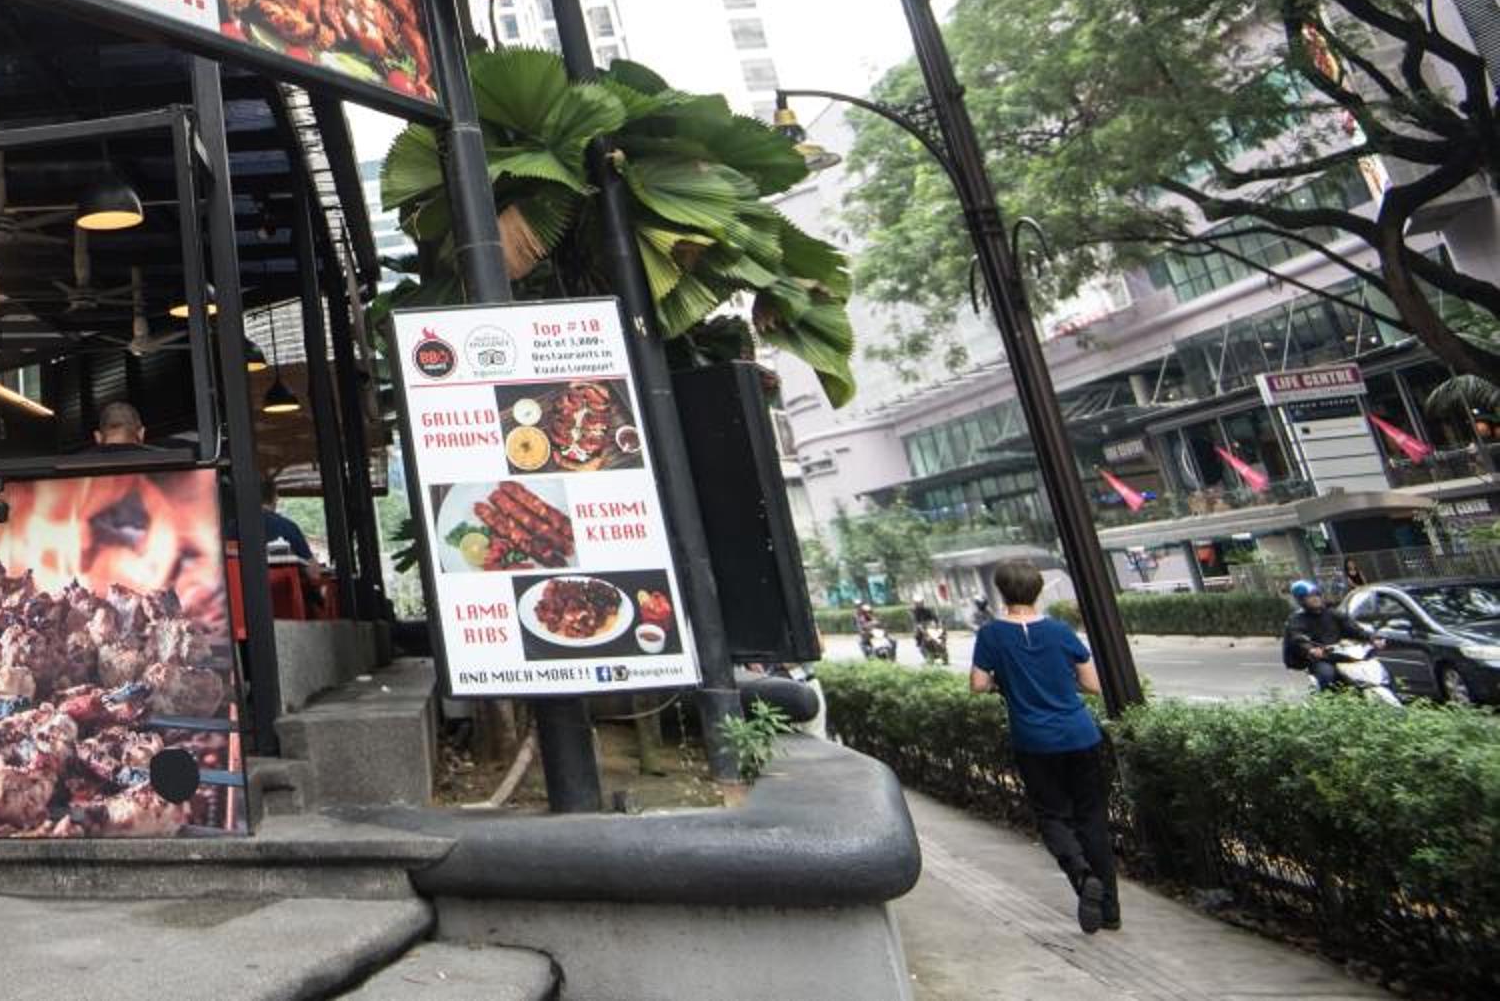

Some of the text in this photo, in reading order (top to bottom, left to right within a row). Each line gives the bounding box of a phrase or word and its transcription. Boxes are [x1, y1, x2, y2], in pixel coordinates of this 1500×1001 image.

[1272, 369, 1354, 390] LIFE CENTRE
[421, 409, 496, 428] GRILLED
[424, 430, 500, 448] PRAWNS
[575, 500, 648, 520] RESHMI
[586, 523, 648, 541] KEBAB
[455, 603, 509, 620] LAMB
[464, 626, 509, 644] RIBS
[459, 671, 488, 685] AND
[491, 669, 533, 683] MUCH
